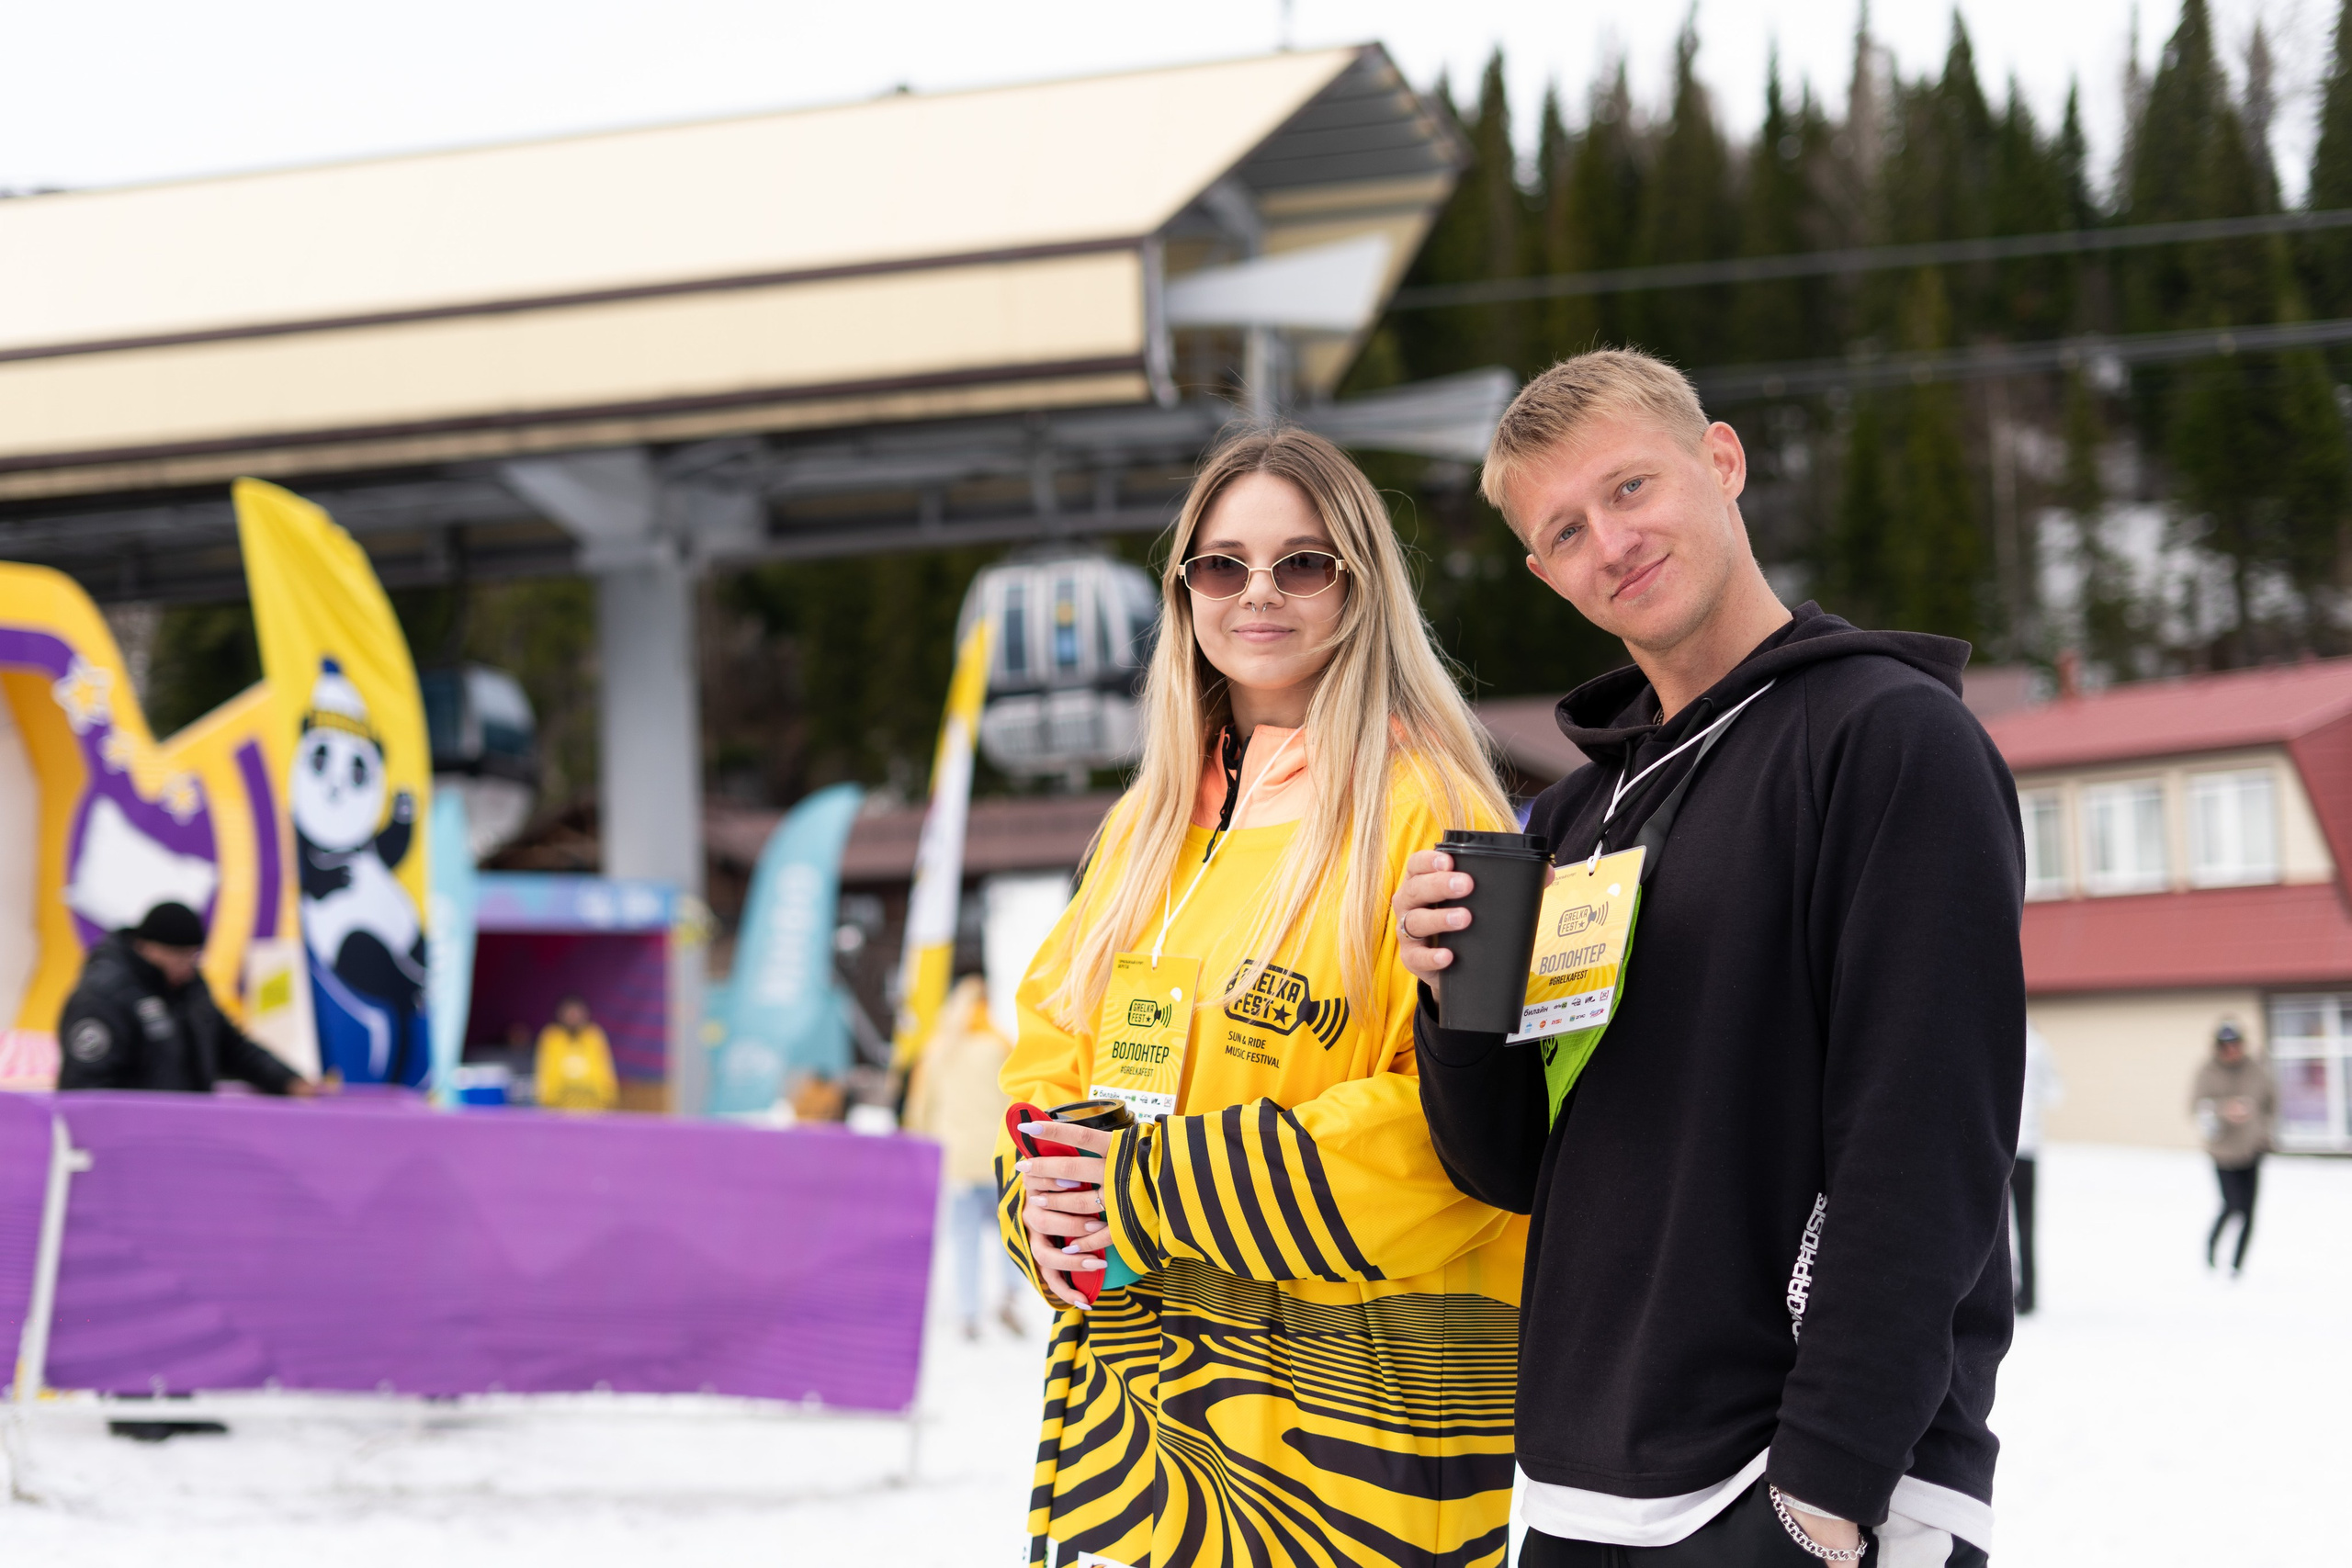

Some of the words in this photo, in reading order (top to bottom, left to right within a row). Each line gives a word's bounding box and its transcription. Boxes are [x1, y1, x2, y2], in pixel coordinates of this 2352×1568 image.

[1564, 908, 1589, 923] GRELKA
[1562, 920, 1579, 933] FEST
[1538, 942, 1606, 976] ВОЛОНТЕР
[1548, 969, 1588, 987] #GRELKAFEST
[1133, 1002, 1155, 1013] GRELKA
[1523, 1006, 1549, 1017] билайн
[1131, 1012, 1147, 1023] FEST
[1227, 1031, 1241, 1043] SUN
[1241, 1035, 1247, 1045] &
[1248, 1036, 1267, 1050] RIDE
[1112, 1041, 1170, 1064] ВОЛОНТЕР
[1225, 1044, 1246, 1060] MUSIC
[1246, 1051, 1280, 1069] FESTIVAL
[1120, 1066, 1154, 1077] #GRELKAFEST
